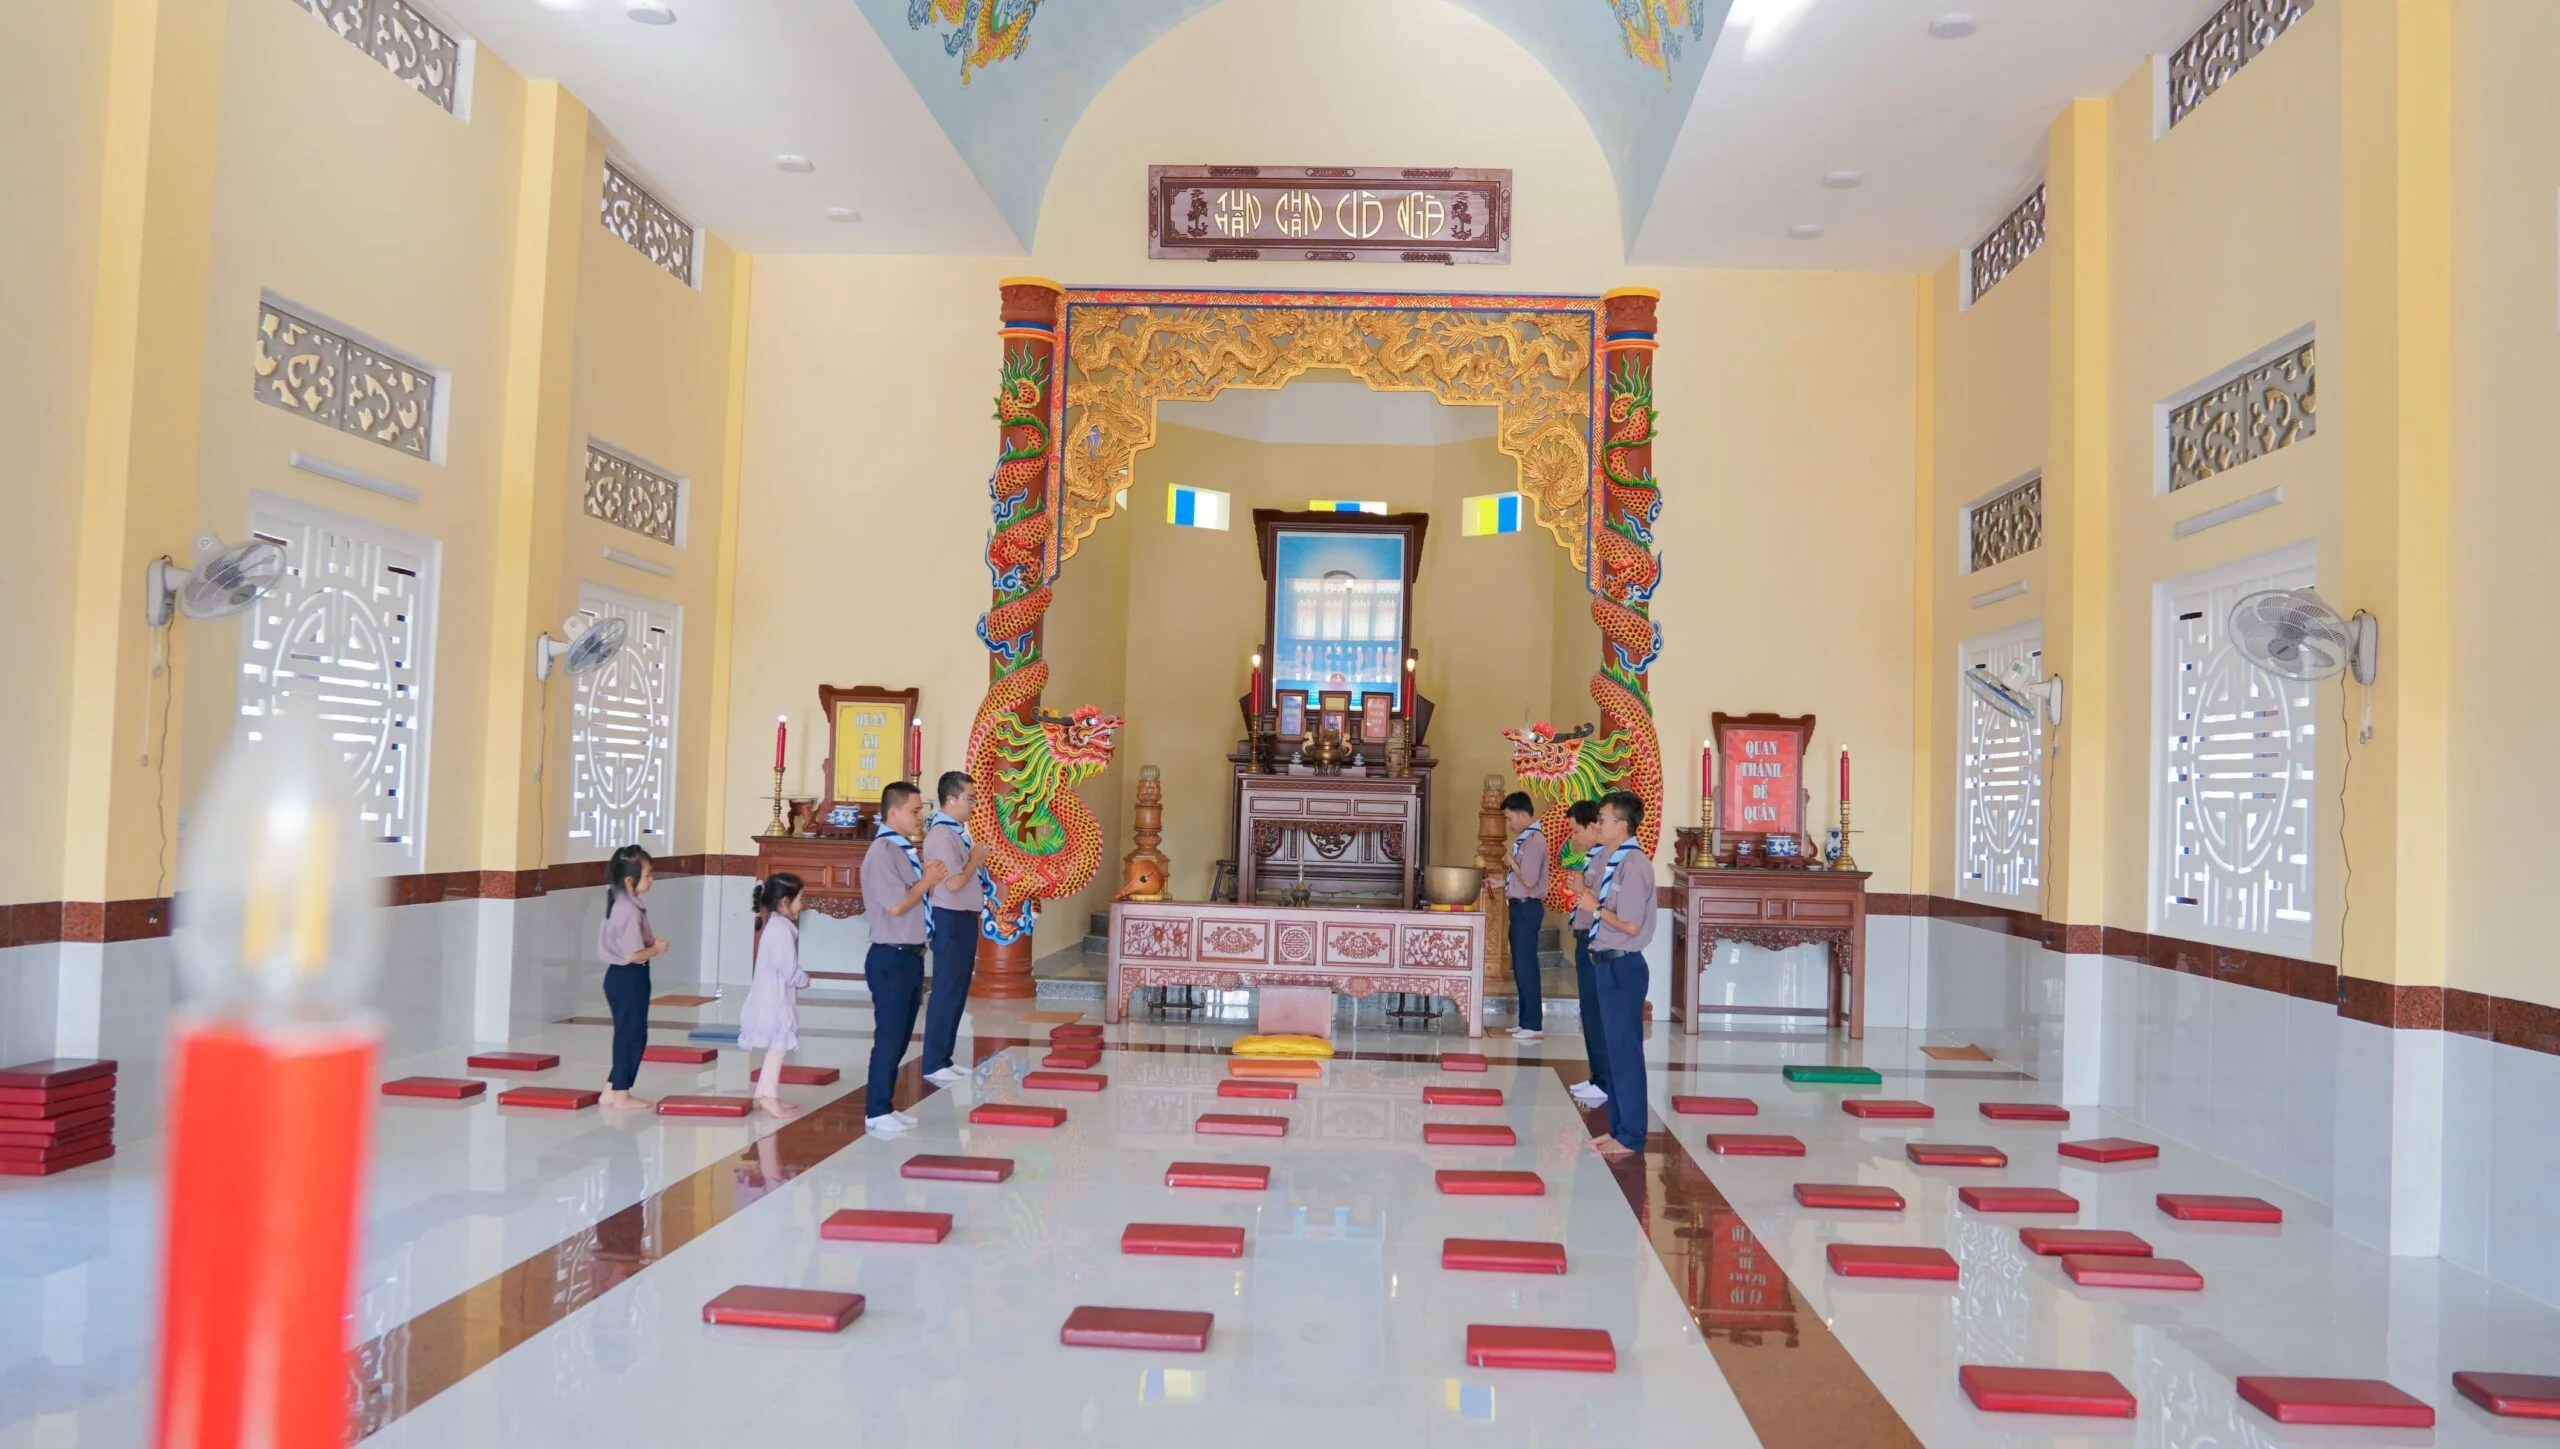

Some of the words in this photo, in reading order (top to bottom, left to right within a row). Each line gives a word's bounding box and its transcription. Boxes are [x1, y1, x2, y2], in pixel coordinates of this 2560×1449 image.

[1397, 191, 1445, 240] NGÃ
[856, 712, 887, 729] QUAN
[1745, 741, 1777, 757] QUAN
[1741, 758, 1782, 778] THÁNH
[1752, 778, 1769, 799] ĐẾ
[1744, 802, 1777, 824] QUÂN
